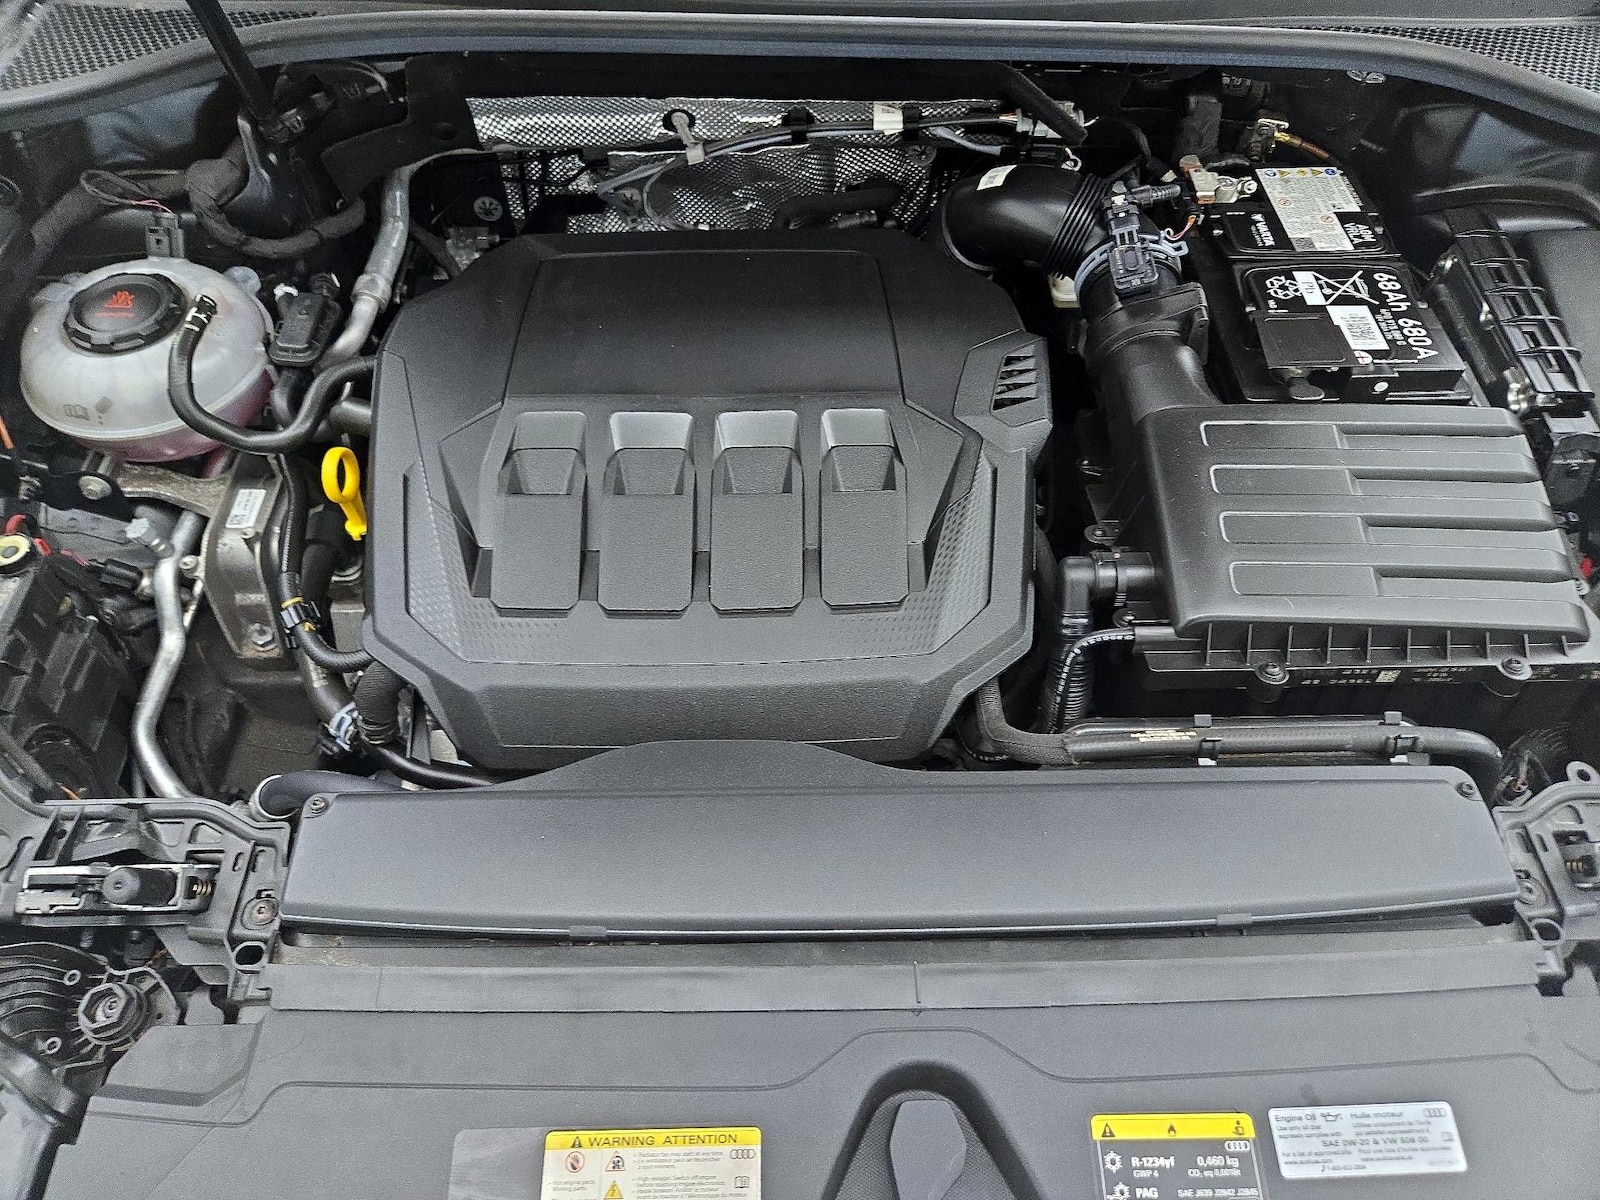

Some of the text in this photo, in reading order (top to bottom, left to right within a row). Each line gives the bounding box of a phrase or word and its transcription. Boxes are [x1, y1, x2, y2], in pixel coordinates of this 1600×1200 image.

[1255, 221, 1276, 247] VARTA
[1343, 222, 1364, 245] VRLA
[1355, 224, 1376, 243] AGM
[1301, 281, 1317, 294] Pb
[1373, 272, 1439, 360] 68Ah 680A
[1274, 1113, 1317, 1123] Engine Oil
[589, 1134, 738, 1147] WARNING ATTENTION
[1322, 1139, 1341, 1147] SAE
[1373, 1137, 1380, 1145] &
[1381, 1137, 1398, 1145] VW
[1131, 1155, 1175, 1169] R-1234yf
[1225, 1155, 1239, 1168] kg
[1135, 1187, 1159, 1199] PAG
[1177, 1189, 1194, 1198] SAE
